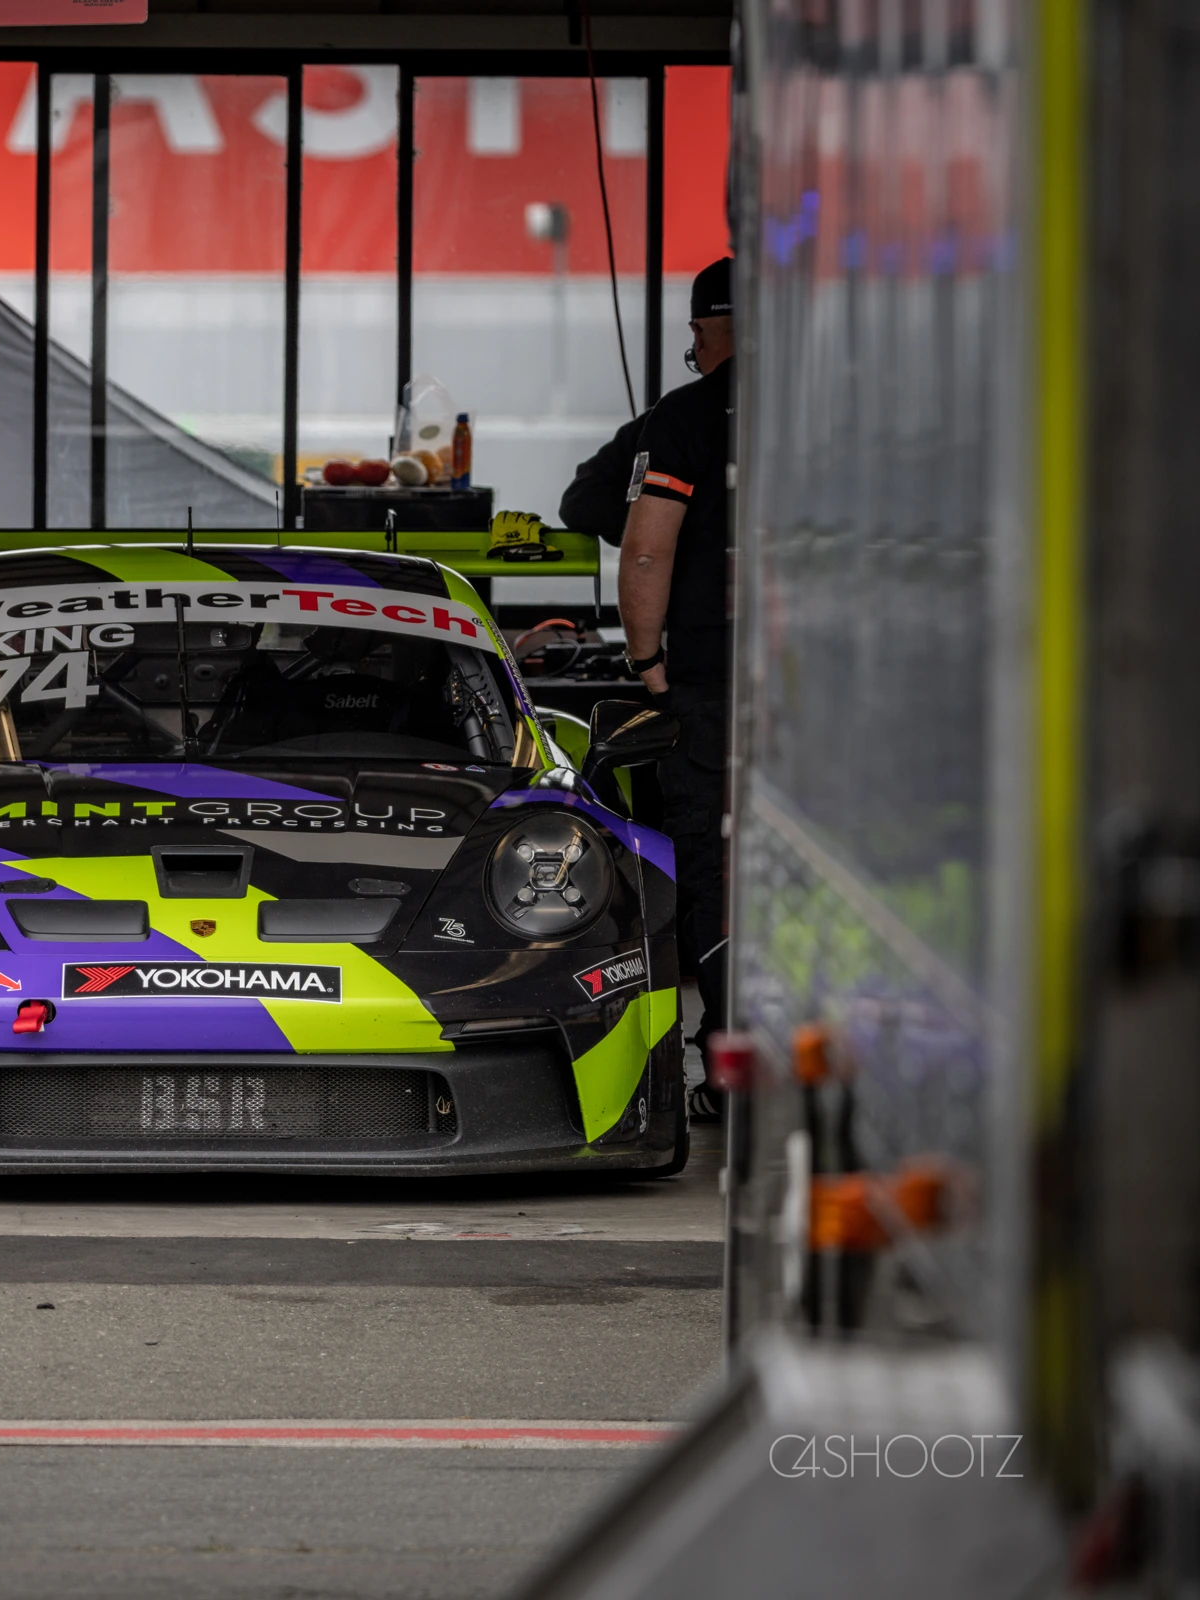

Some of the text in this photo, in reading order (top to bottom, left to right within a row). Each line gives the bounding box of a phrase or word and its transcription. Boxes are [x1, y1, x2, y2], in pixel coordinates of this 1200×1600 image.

[324, 693, 379, 709] Sabelt
[203, 817, 444, 832] PROCESSING
[438, 917, 466, 938] 75
[134, 967, 326, 993] YOKOHAMA
[602, 957, 645, 984] YOKOHAMA
